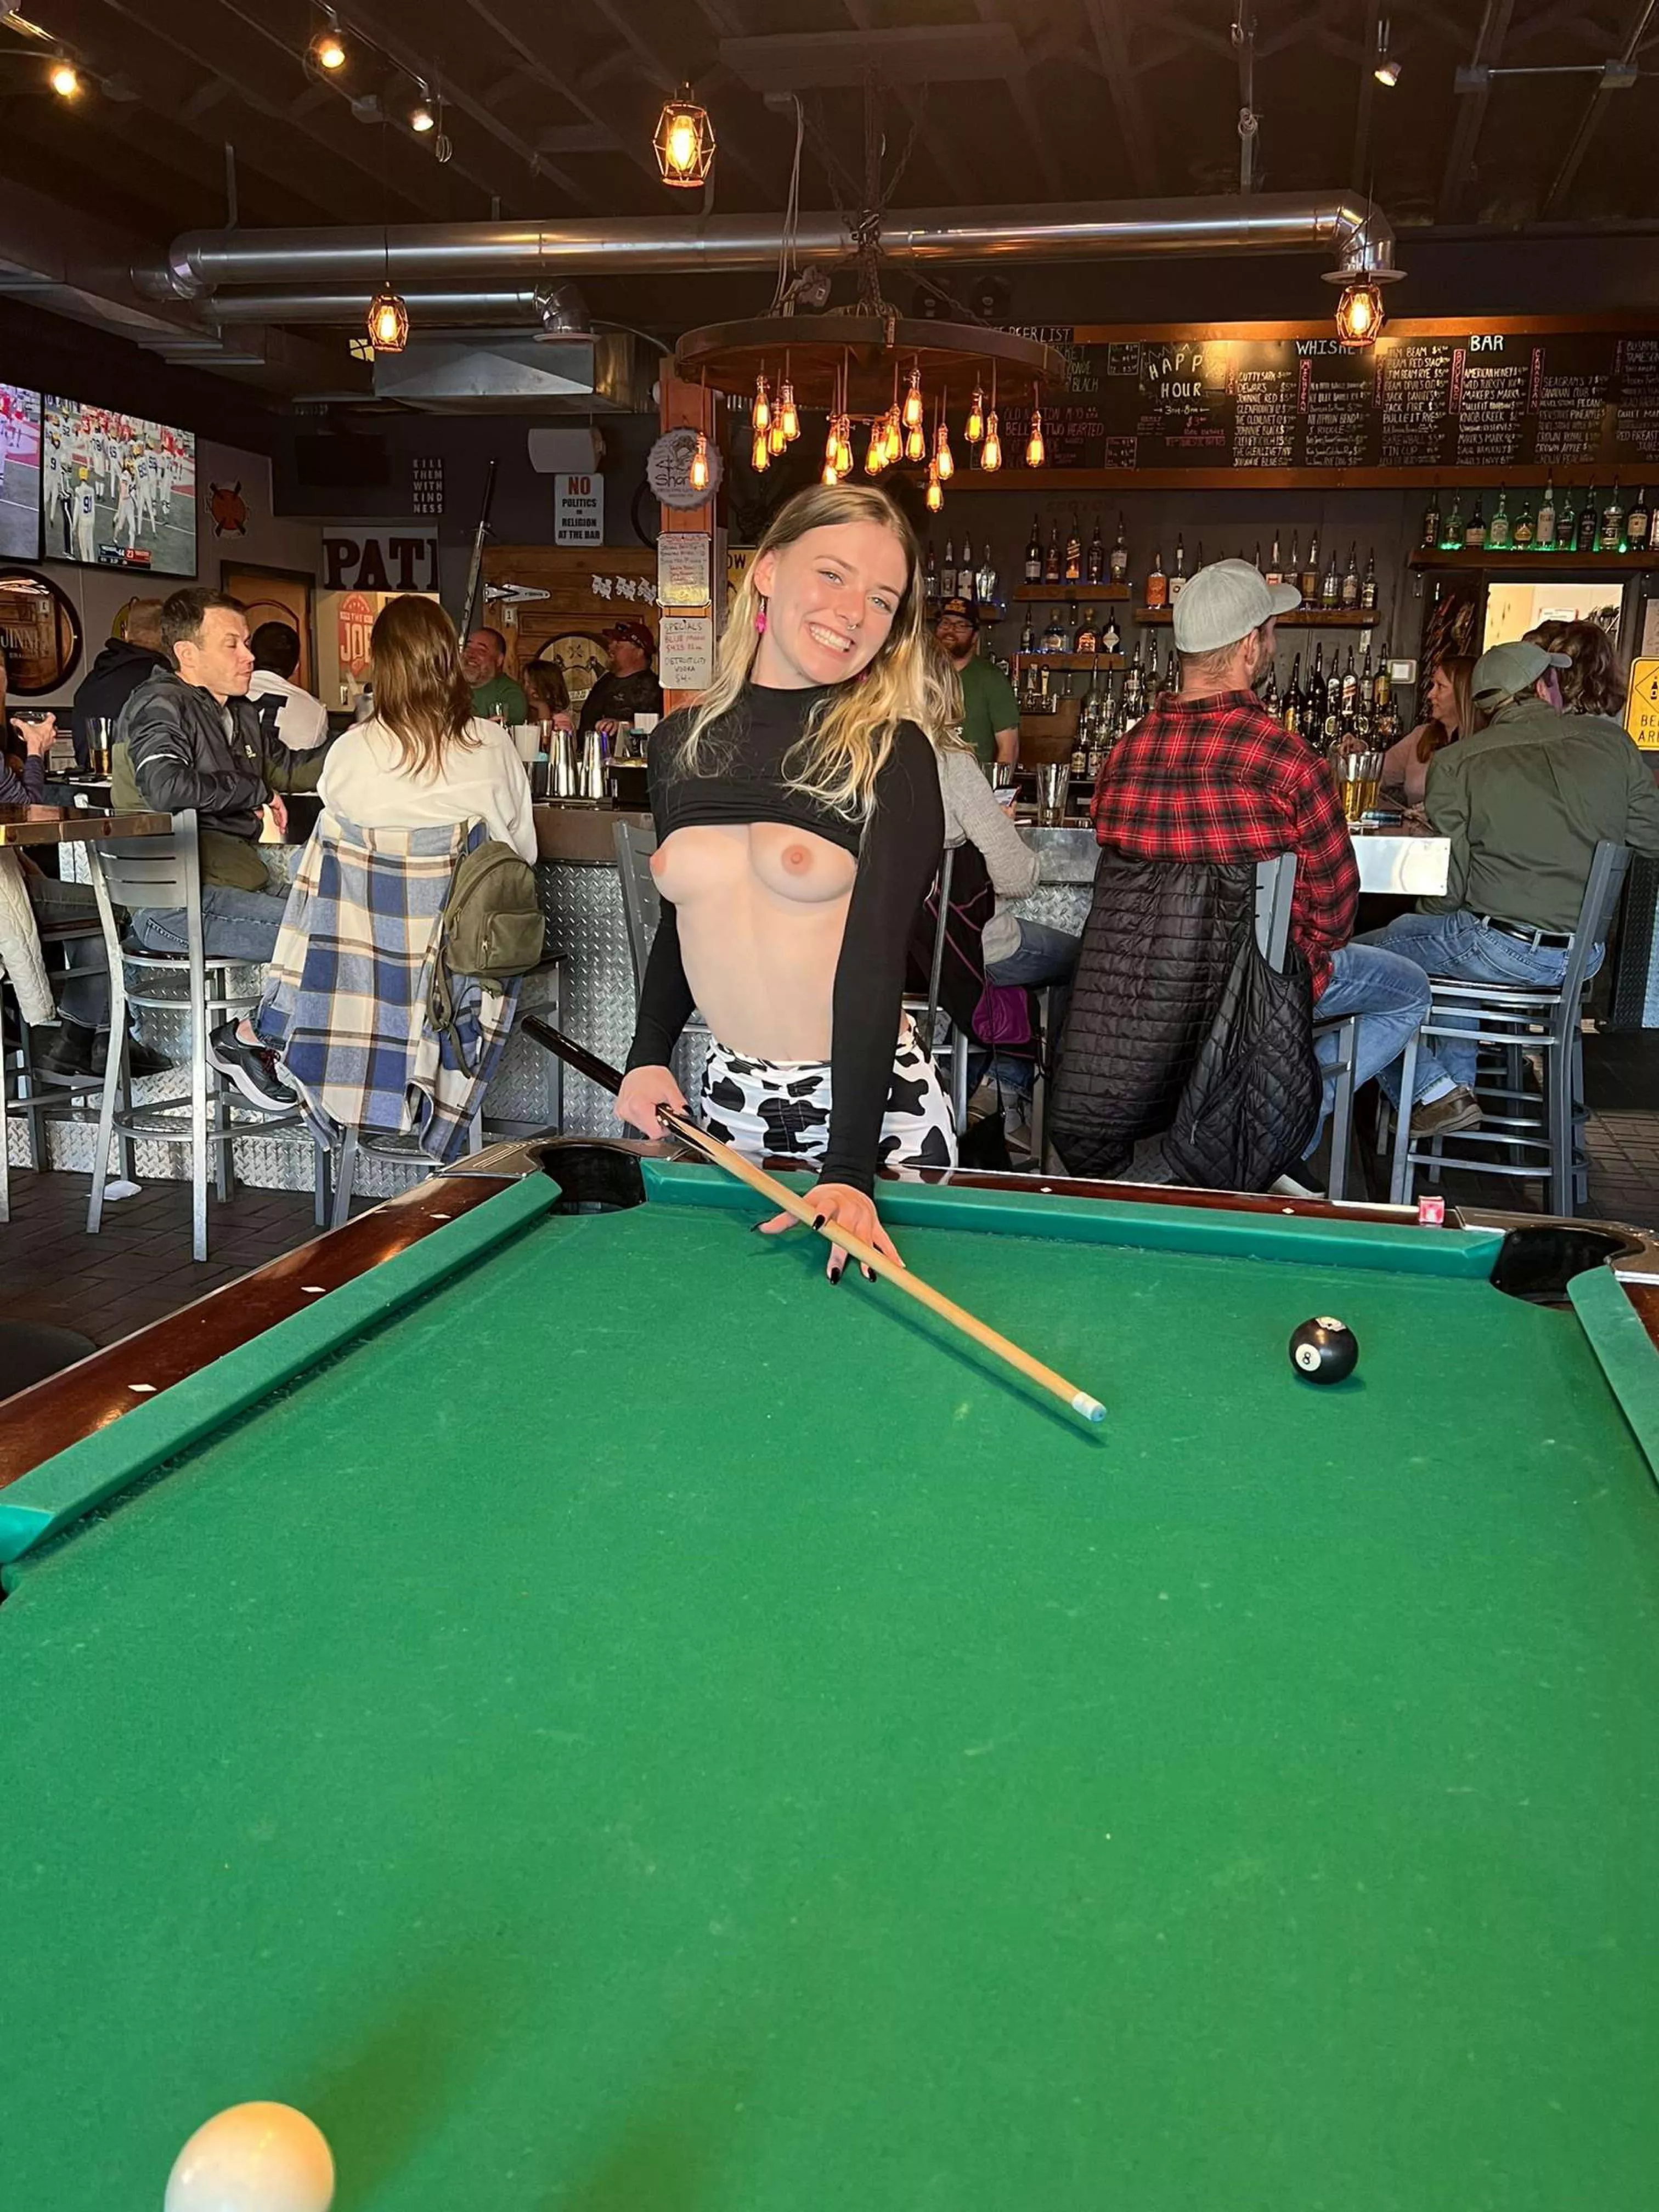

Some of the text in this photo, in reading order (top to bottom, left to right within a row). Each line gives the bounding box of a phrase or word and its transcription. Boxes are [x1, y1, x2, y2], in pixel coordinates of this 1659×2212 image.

[1041, 328, 1071, 342] LIST
[1470, 335, 1504, 351] BAR
[1407, 347, 1426, 357] BEAM
[1149, 353, 1203, 380] HAPP
[1401, 369, 1418, 379] BEAM
[1419, 369, 1431, 379] RYE
[1161, 382, 1203, 398] HOUR
[1385, 392, 1403, 402] JACK
[1384, 403, 1403, 414] JACK
[1383, 413, 1421, 424] BULLEIT
[413, 459, 442, 469] KILL
[413, 470, 443, 479] THEM
[413, 481, 443, 491] WITH
[569, 476, 591, 495] NO
[413, 492, 443, 503] KIND
[562, 498, 597, 507] POLITICS
[413, 504, 443, 514] NESS
[562, 518, 597, 527] RELIGION
[558, 531, 600, 539] AT THE BAR
[351, 613, 365, 622] THE
[1302, 1351, 1311, 1365] 8
